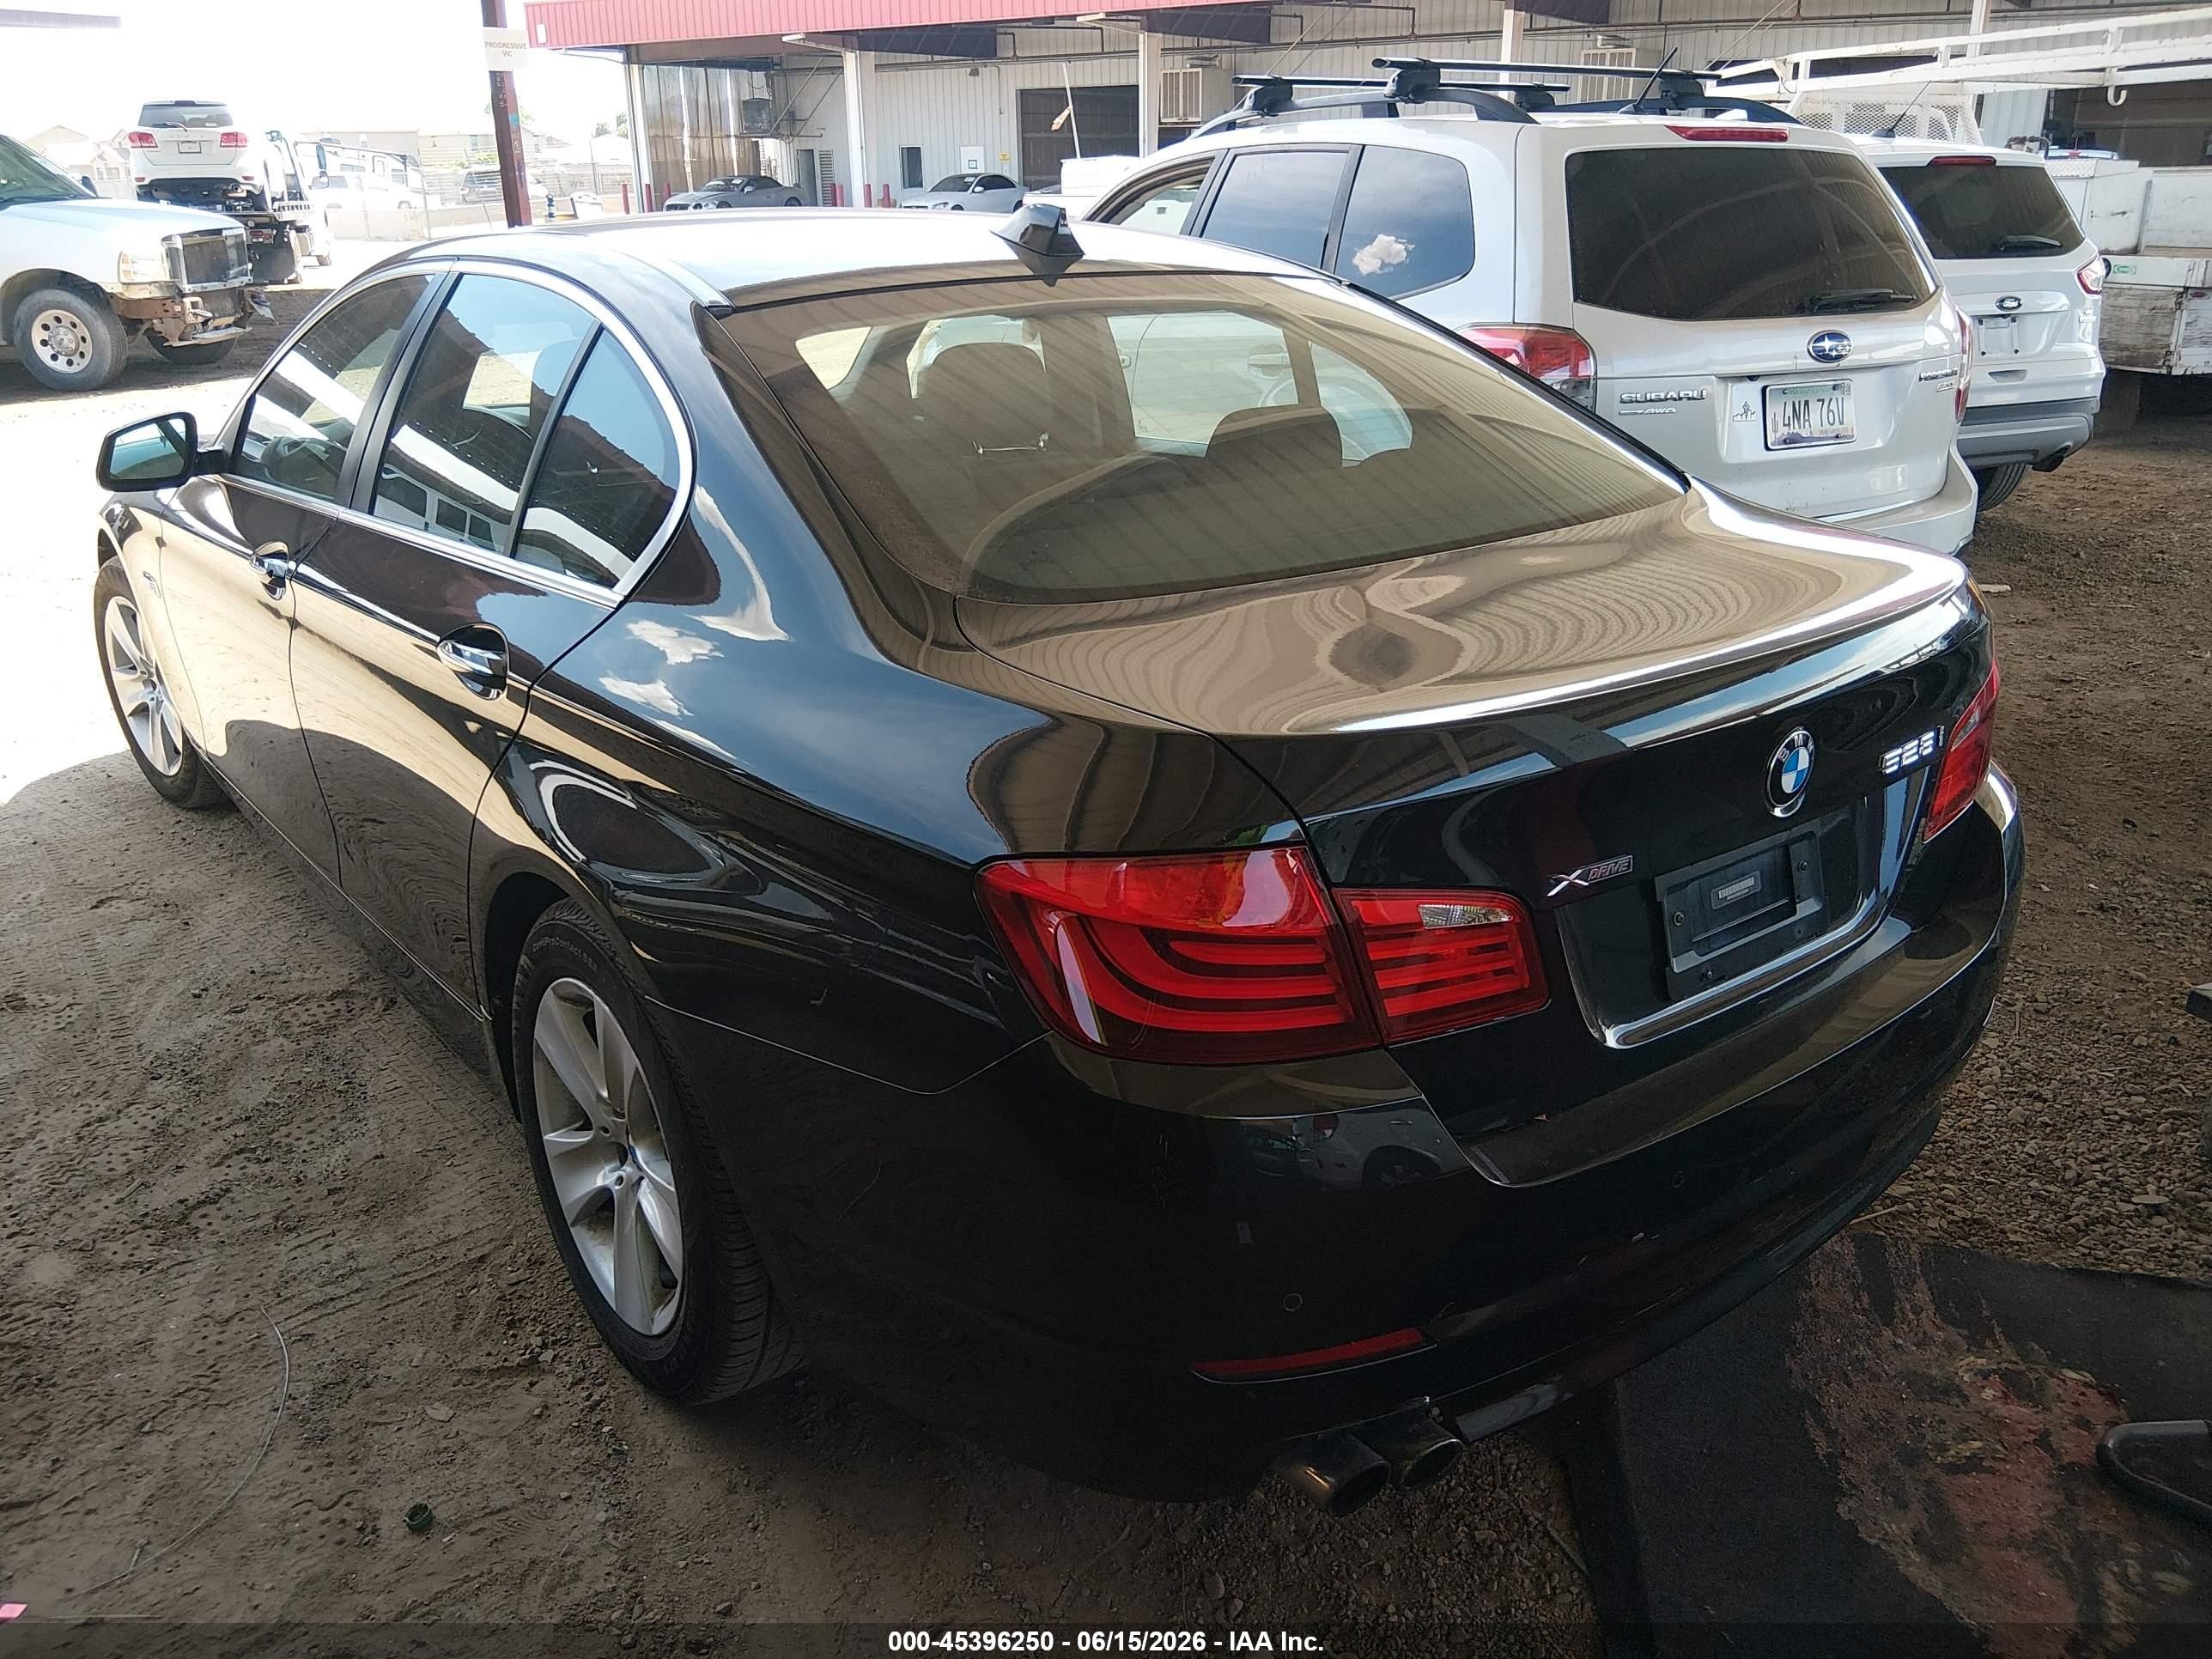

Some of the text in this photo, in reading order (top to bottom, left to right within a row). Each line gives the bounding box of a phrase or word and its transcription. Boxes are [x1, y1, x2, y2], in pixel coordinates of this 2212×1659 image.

[484, 41, 528, 50] PROGRESSIVE
[1620, 390, 1707, 404] SUBARU
[1783, 397, 1844, 430] 4NA 76V
[1778, 733, 1814, 763] BMW
